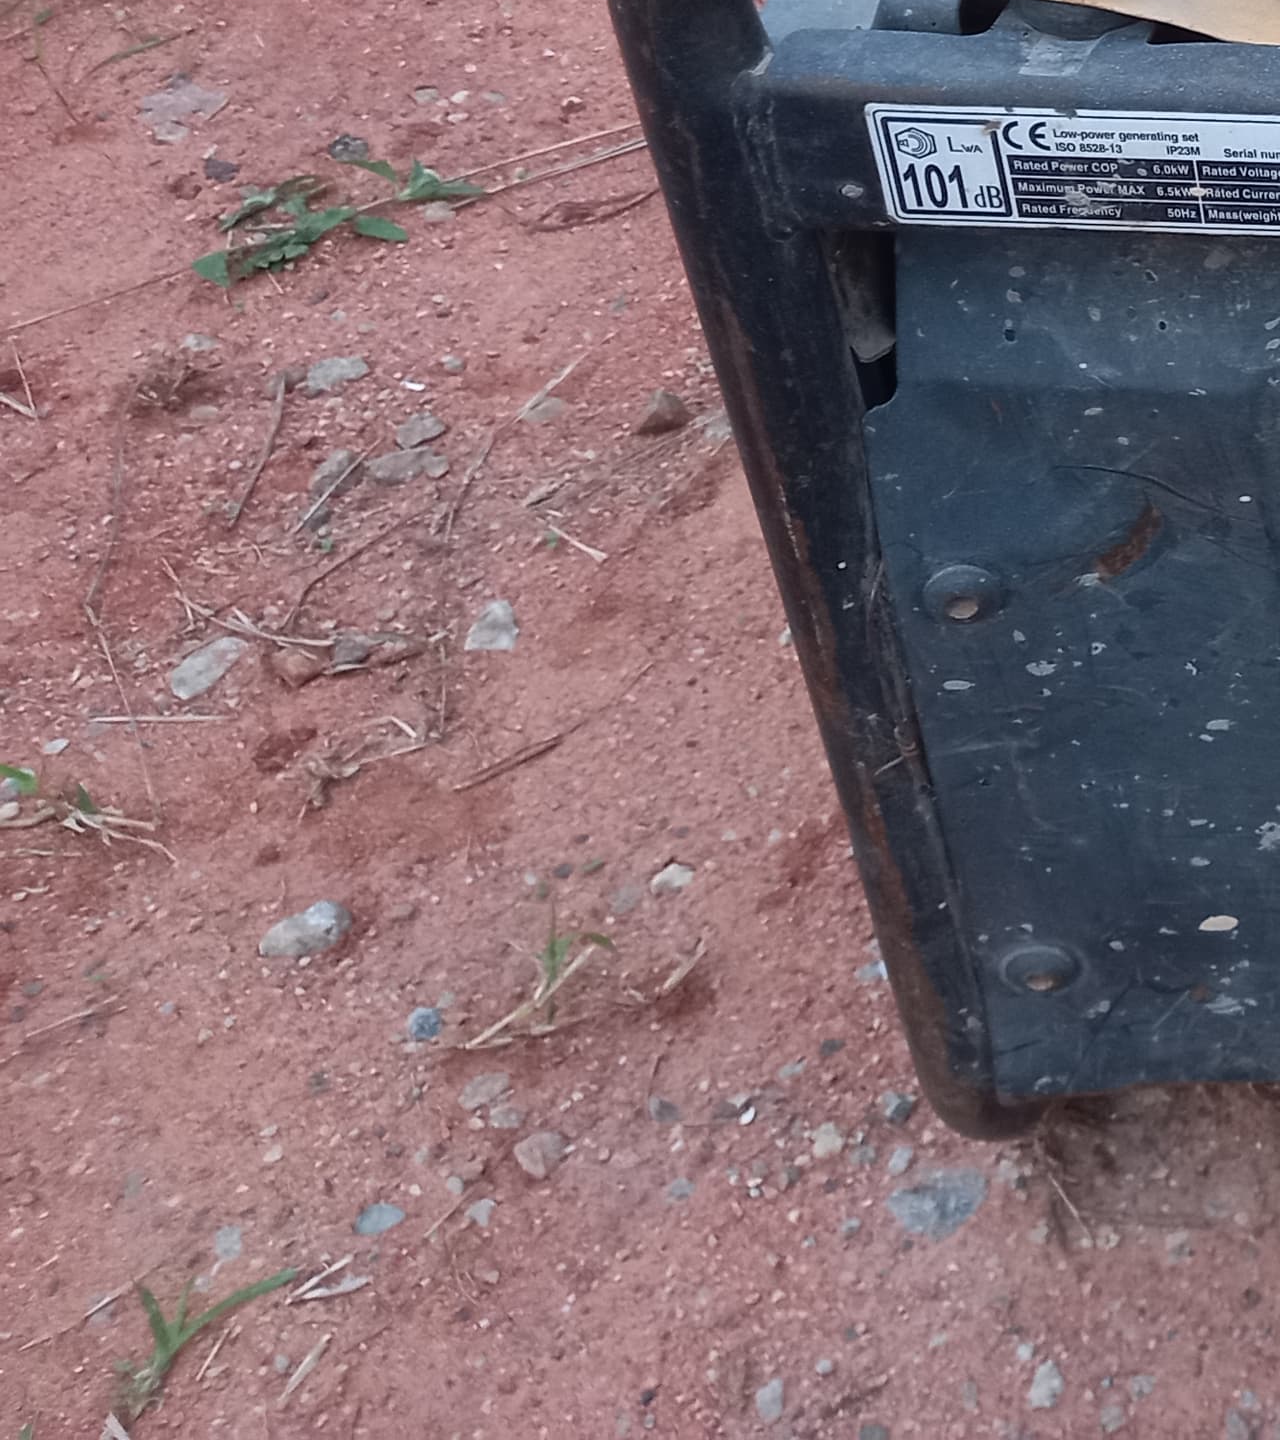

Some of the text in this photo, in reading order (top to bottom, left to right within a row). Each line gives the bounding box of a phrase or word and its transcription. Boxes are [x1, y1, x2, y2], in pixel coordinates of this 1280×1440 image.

[1053, 128, 1200, 144] Low-power generating set
[1055, 142, 1123, 154] ISO 8528-13
[1167, 145, 1200, 156] IP23M
[1223, 147, 1257, 159] Serial
[1013, 160, 1118, 173] Rated Power COP
[1152, 164, 1190, 175] 6.0kW
[1202, 165, 1237, 177] Rated
[902, 164, 1004, 209] 101 dB
[1018, 181, 1146, 196] Maximum Power MAX
[1156, 186, 1194, 198] 6.5kW
[1205, 187, 1240, 199] Rated
[1022, 203, 1057, 215] Rated
[1167, 208, 1197, 219] 50Hz
